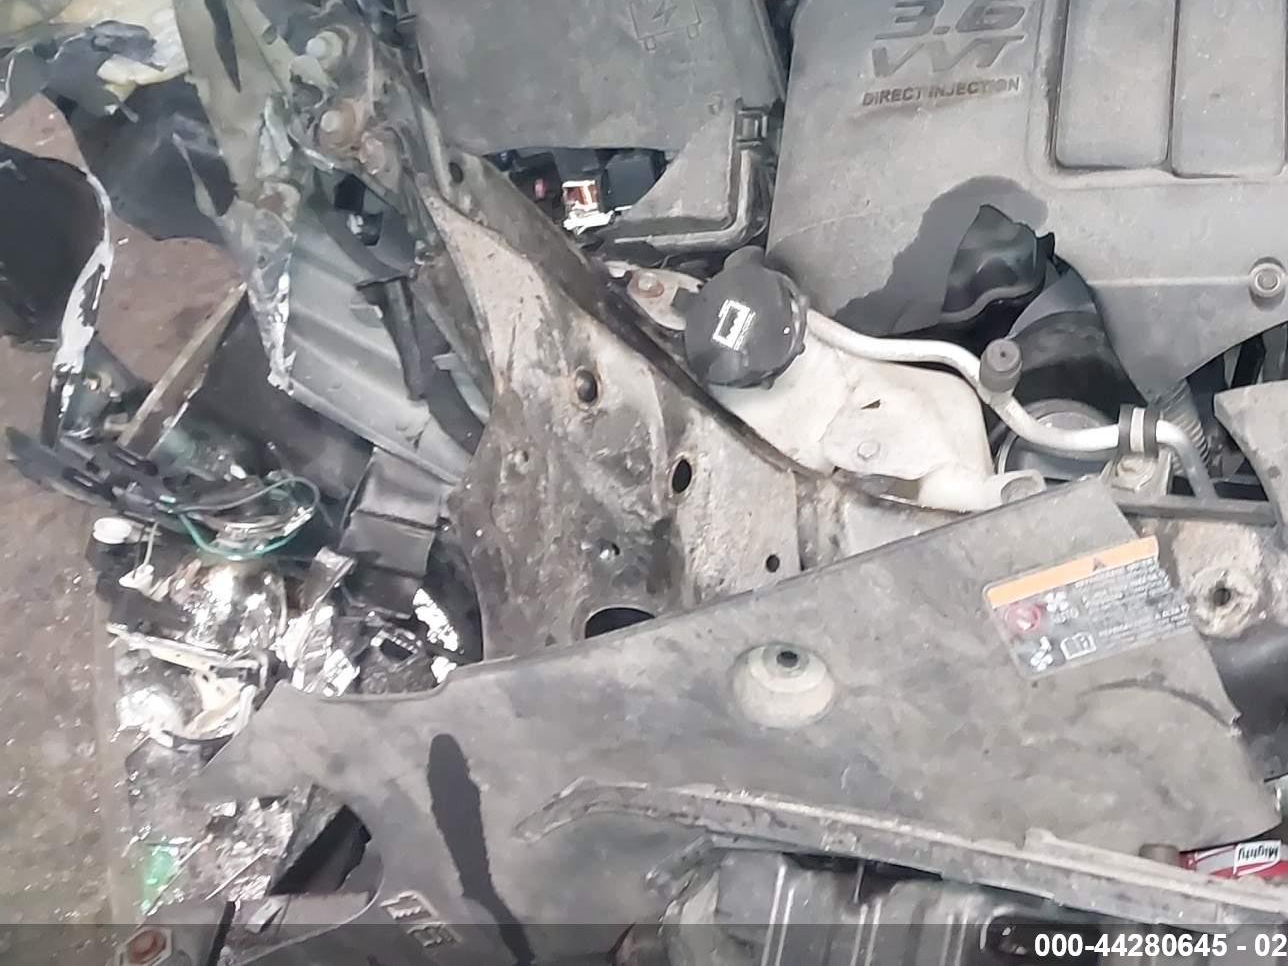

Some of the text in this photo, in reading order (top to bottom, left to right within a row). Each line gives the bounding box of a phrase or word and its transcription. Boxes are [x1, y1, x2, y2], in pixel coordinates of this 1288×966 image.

[870, 34, 1025, 78] VVT
[862, 77, 1020, 107] DIRECT INJECTION
[1237, 845, 1279, 860] Mighty
